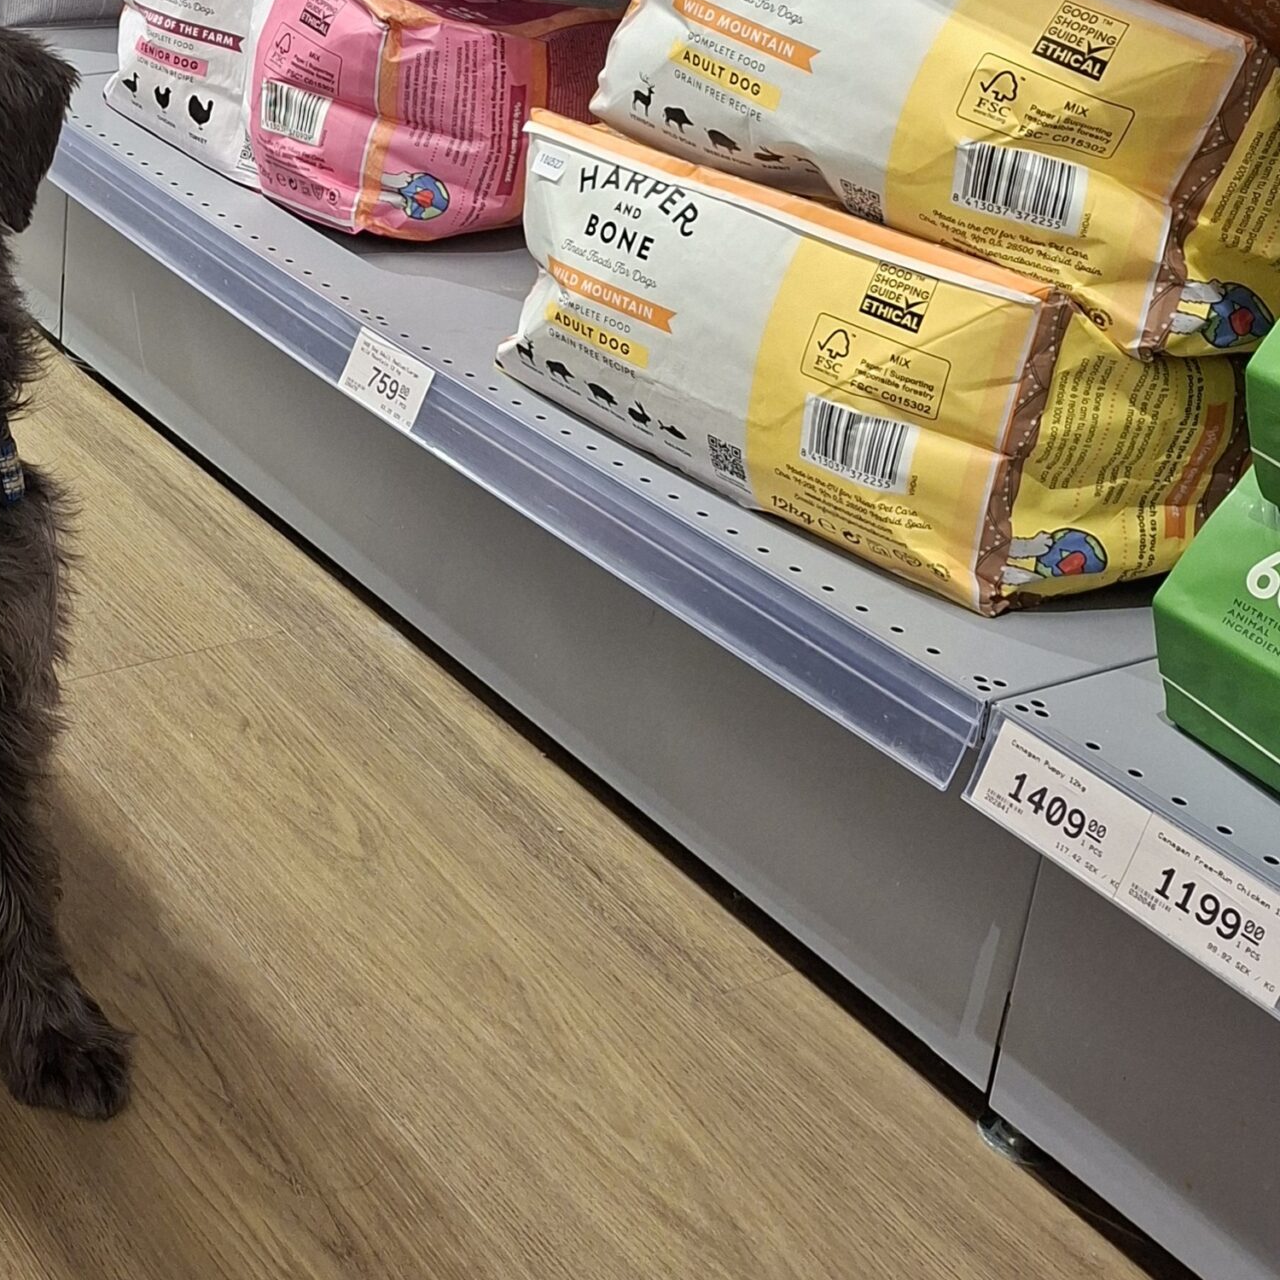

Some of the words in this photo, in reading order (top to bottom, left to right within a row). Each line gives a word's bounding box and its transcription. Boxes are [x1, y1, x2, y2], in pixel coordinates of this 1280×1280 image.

[777, 4, 804, 26] Dogs
[1061, 4, 1098, 25] GOOD
[164, 17, 177, 30] OF
[179, 21, 200, 38] THE
[202, 28, 234, 47] FARM
[719, 14, 795, 59] MOUNTAIN
[1047, 26, 1085, 48] GUIDE
[1054, 15, 1117, 46] SHOPPING
[140, 42, 171, 63] SENIOR
[173, 55, 199, 71] DOG
[688, 31, 735, 61] COMPLETE
[737, 55, 766, 74] FOOD
[1035, 40, 1101, 78] ETHICAL
[683, 49, 725, 80] ADULT
[729, 72, 761, 97] DOG
[673, 68, 702, 92] GRAIN
[704, 84, 726, 104] FREE
[728, 96, 762, 123] RECIPE
[976, 97, 1011, 118] FSC
[1064, 101, 1089, 118] MIX
[1052, 133, 1106, 155] C015302
[579, 164, 699, 237] HARPER
[613, 202, 642, 220] AND
[1015, 210, 1061, 230] 372255
[584, 214, 655, 260] BONE
[632, 270, 657, 289] Dogs
[880, 262, 913, 281] GOOD
[553, 265, 578, 286] WILD
[580, 281, 654, 319] MOUNTAIN
[870, 285, 903, 304] GUIDE
[874, 274, 930, 301] SHOPPING
[603, 316, 631, 334] FOOD
[862, 298, 919, 330] ETHICAL
[555, 312, 594, 340] ADULT
[599, 332, 630, 356] DOG
[548, 328, 576, 349] GRAIN
[579, 342, 600, 361] FREE
[601, 353, 635, 378] RECIPE
[890, 354, 912, 369] MIX
[367, 366, 399, 400] 759
[881, 391, 931, 414] C015302
[1246, 551, 1280, 608] 6
[1227, 609, 1270, 637] ANIMAL
[1011, 739, 1041, 762] Canagan
[1008, 773, 1086, 840] 1409
[1055, 841, 1081, 863] 117.42
[1084, 860, 1099, 875] SEK
[1089, 843, 1103, 858] PCS
[1158, 831, 1191, 858] Canagan
[1193, 855, 1233, 885] Free-Run
[1236, 881, 1271, 910] Chicken
[1155, 868, 1241, 940] 1199
[1245, 946, 1260, 962] PCS
[1235, 962, 1251, 977] SEK
